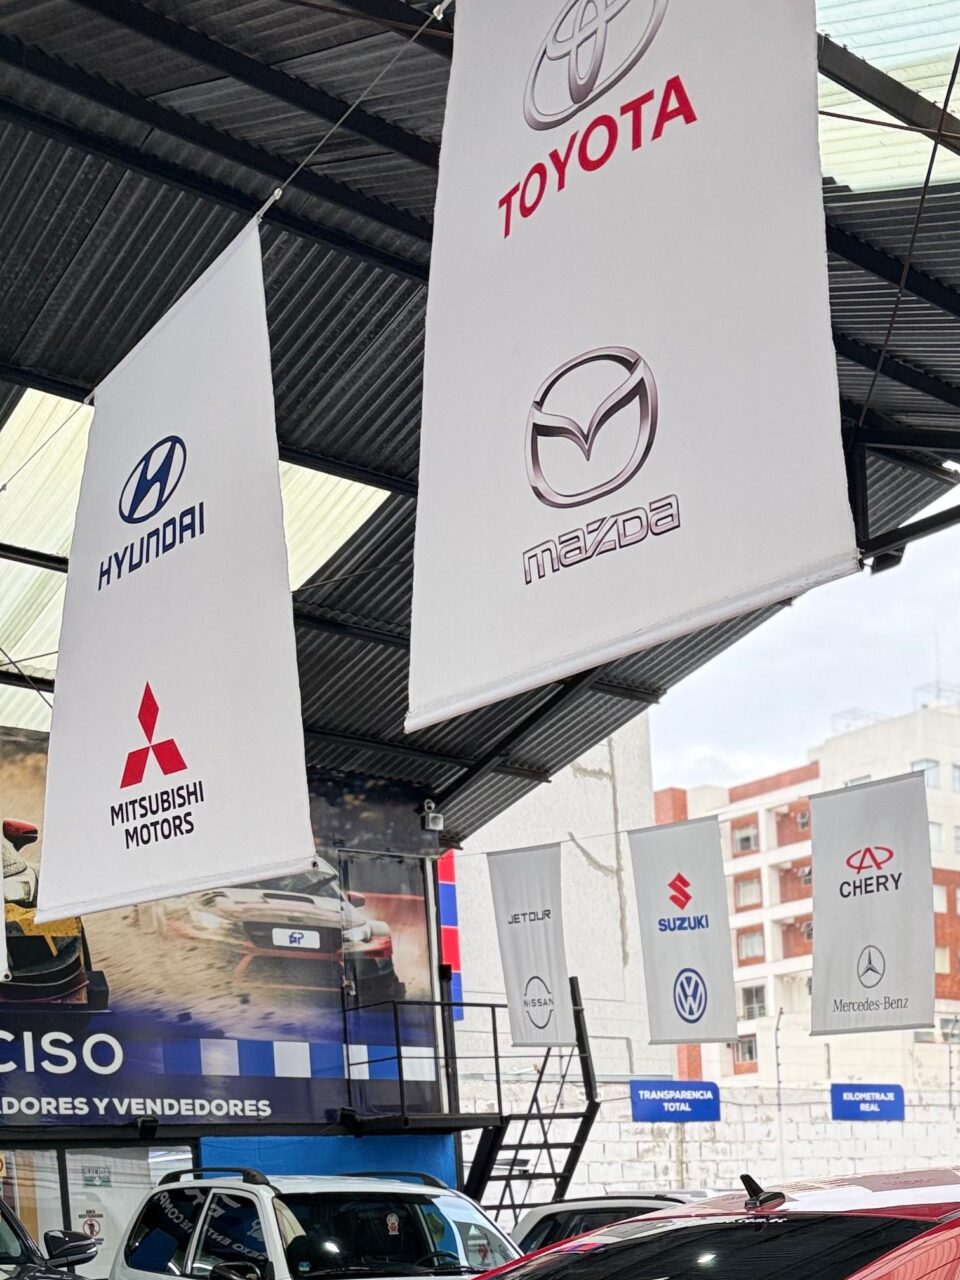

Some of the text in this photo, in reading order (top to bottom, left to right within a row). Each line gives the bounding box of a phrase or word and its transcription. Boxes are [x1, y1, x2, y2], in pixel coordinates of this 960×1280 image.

[498, 75, 697, 239] TOYOTA
[98, 501, 205, 591] HYUNDAI
[110, 780, 204, 826] MITSUBISHI
[124, 811, 194, 850] MOTORS
[839, 872, 903, 899] CHERY
[507, 909, 551, 925] JETOUR
[658, 914, 710, 932] SUZUKI
[523, 997, 554, 1007] NISSAN
[832, 994, 909, 1013] Mercedes-Benz
[638, 1089, 713, 1102] TRANSPARENCIA
[842, 1092, 895, 1103] KILOMETRAJE
[0, 1097, 272, 1117] DORES Y VENDEDORES
[663, 1102, 692, 1113] TOTAL
[860, 1103, 880, 1112] REAL
